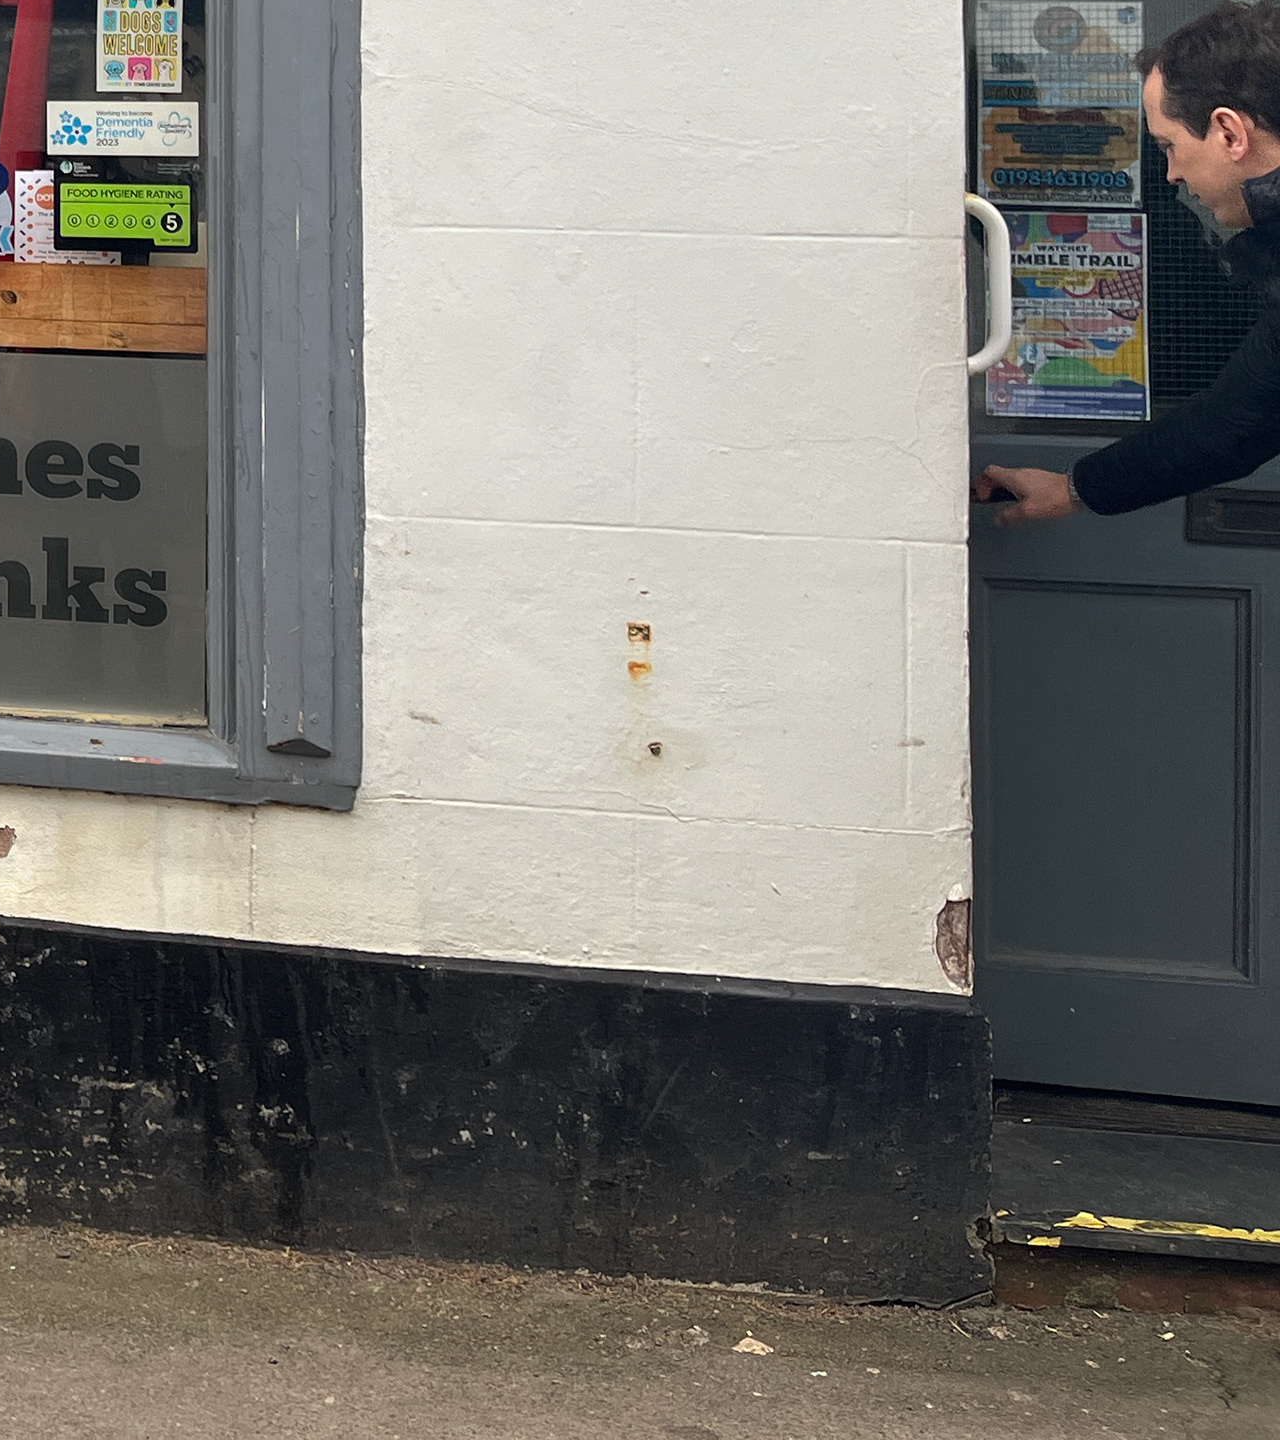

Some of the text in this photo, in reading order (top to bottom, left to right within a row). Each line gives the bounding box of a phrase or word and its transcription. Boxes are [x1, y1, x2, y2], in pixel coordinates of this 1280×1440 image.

[120, 11, 162, 33] DOGS
[103, 34, 178, 57] WELCOME
[96, 117, 153, 127] Dementia
[96, 128, 145, 140] Friendly
[67, 188, 183, 199] FOOD HYGIENE RATING
[166, 214, 178, 231] 5
[1076, 255, 1134, 267] TRAIL
